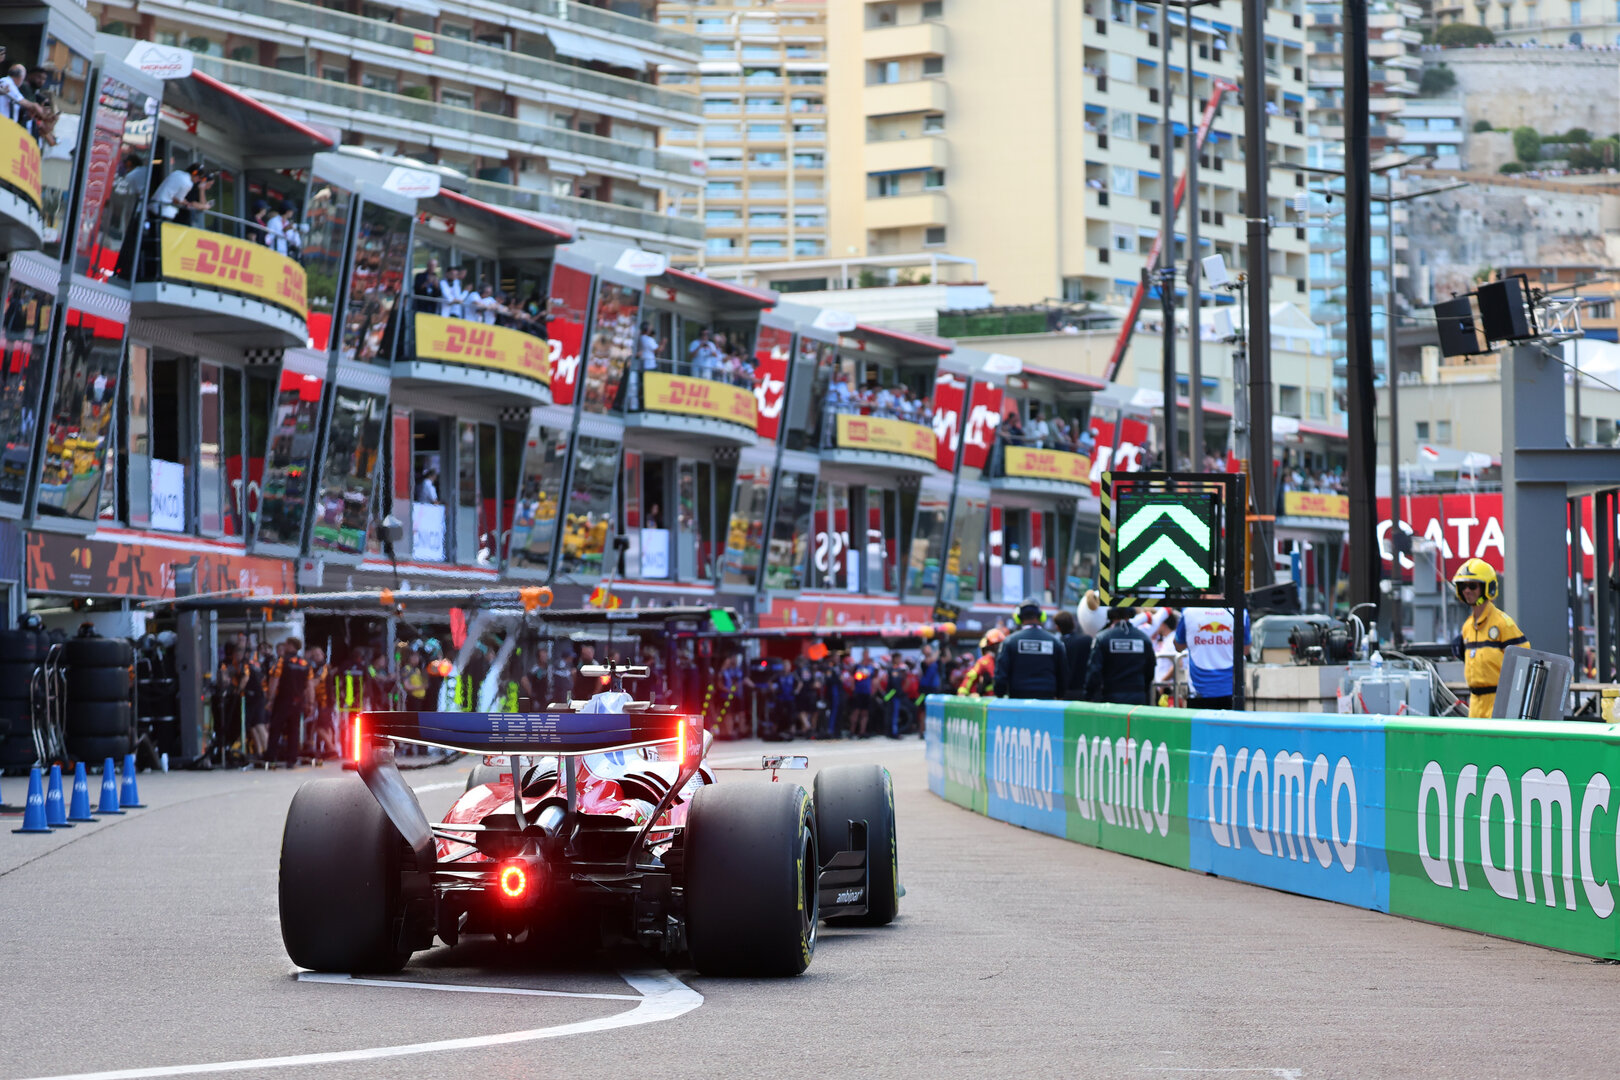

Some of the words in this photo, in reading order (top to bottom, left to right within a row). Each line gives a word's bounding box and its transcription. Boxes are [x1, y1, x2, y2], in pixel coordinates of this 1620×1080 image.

[195, 238, 255, 285] DHL
[445, 324, 498, 359] DHL
[669, 381, 712, 409] DHL
[1377, 517, 1504, 569] QATA
[1194, 635, 1215, 645] Red
[488, 714, 561, 742] IBM
[994, 725, 1053, 812] aramco
[1075, 734, 1171, 837] aramco
[29, 795, 43, 804] FIA
[1208, 744, 1358, 873] aramco
[1418, 760, 1620, 919] aramc
[836, 889, 862, 904] ambipar
